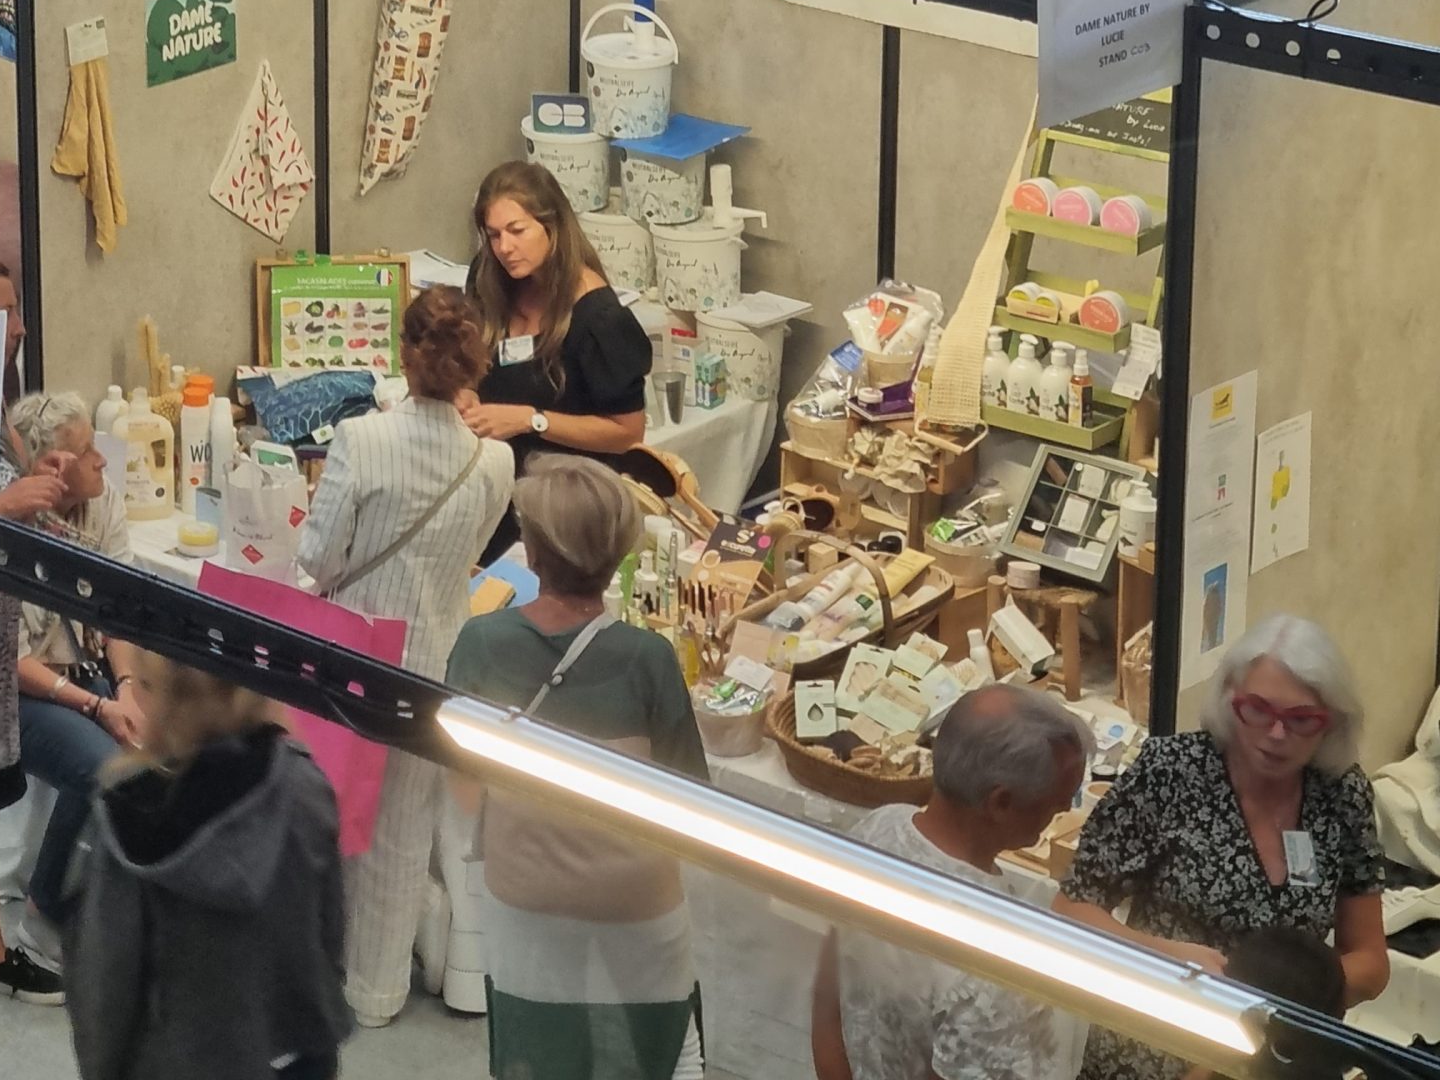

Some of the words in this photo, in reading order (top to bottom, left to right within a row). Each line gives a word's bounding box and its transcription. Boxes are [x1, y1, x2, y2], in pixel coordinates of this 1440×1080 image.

[169, 1, 213, 36] DAME
[1075, 18, 1101, 36] DAME
[1103, 8, 1137, 25] NATURE
[1139, 3, 1151, 16] BY
[162, 22, 223, 62] NATURE
[1101, 30, 1125, 46] LUCIE
[1099, 49, 1127, 68] STAND
